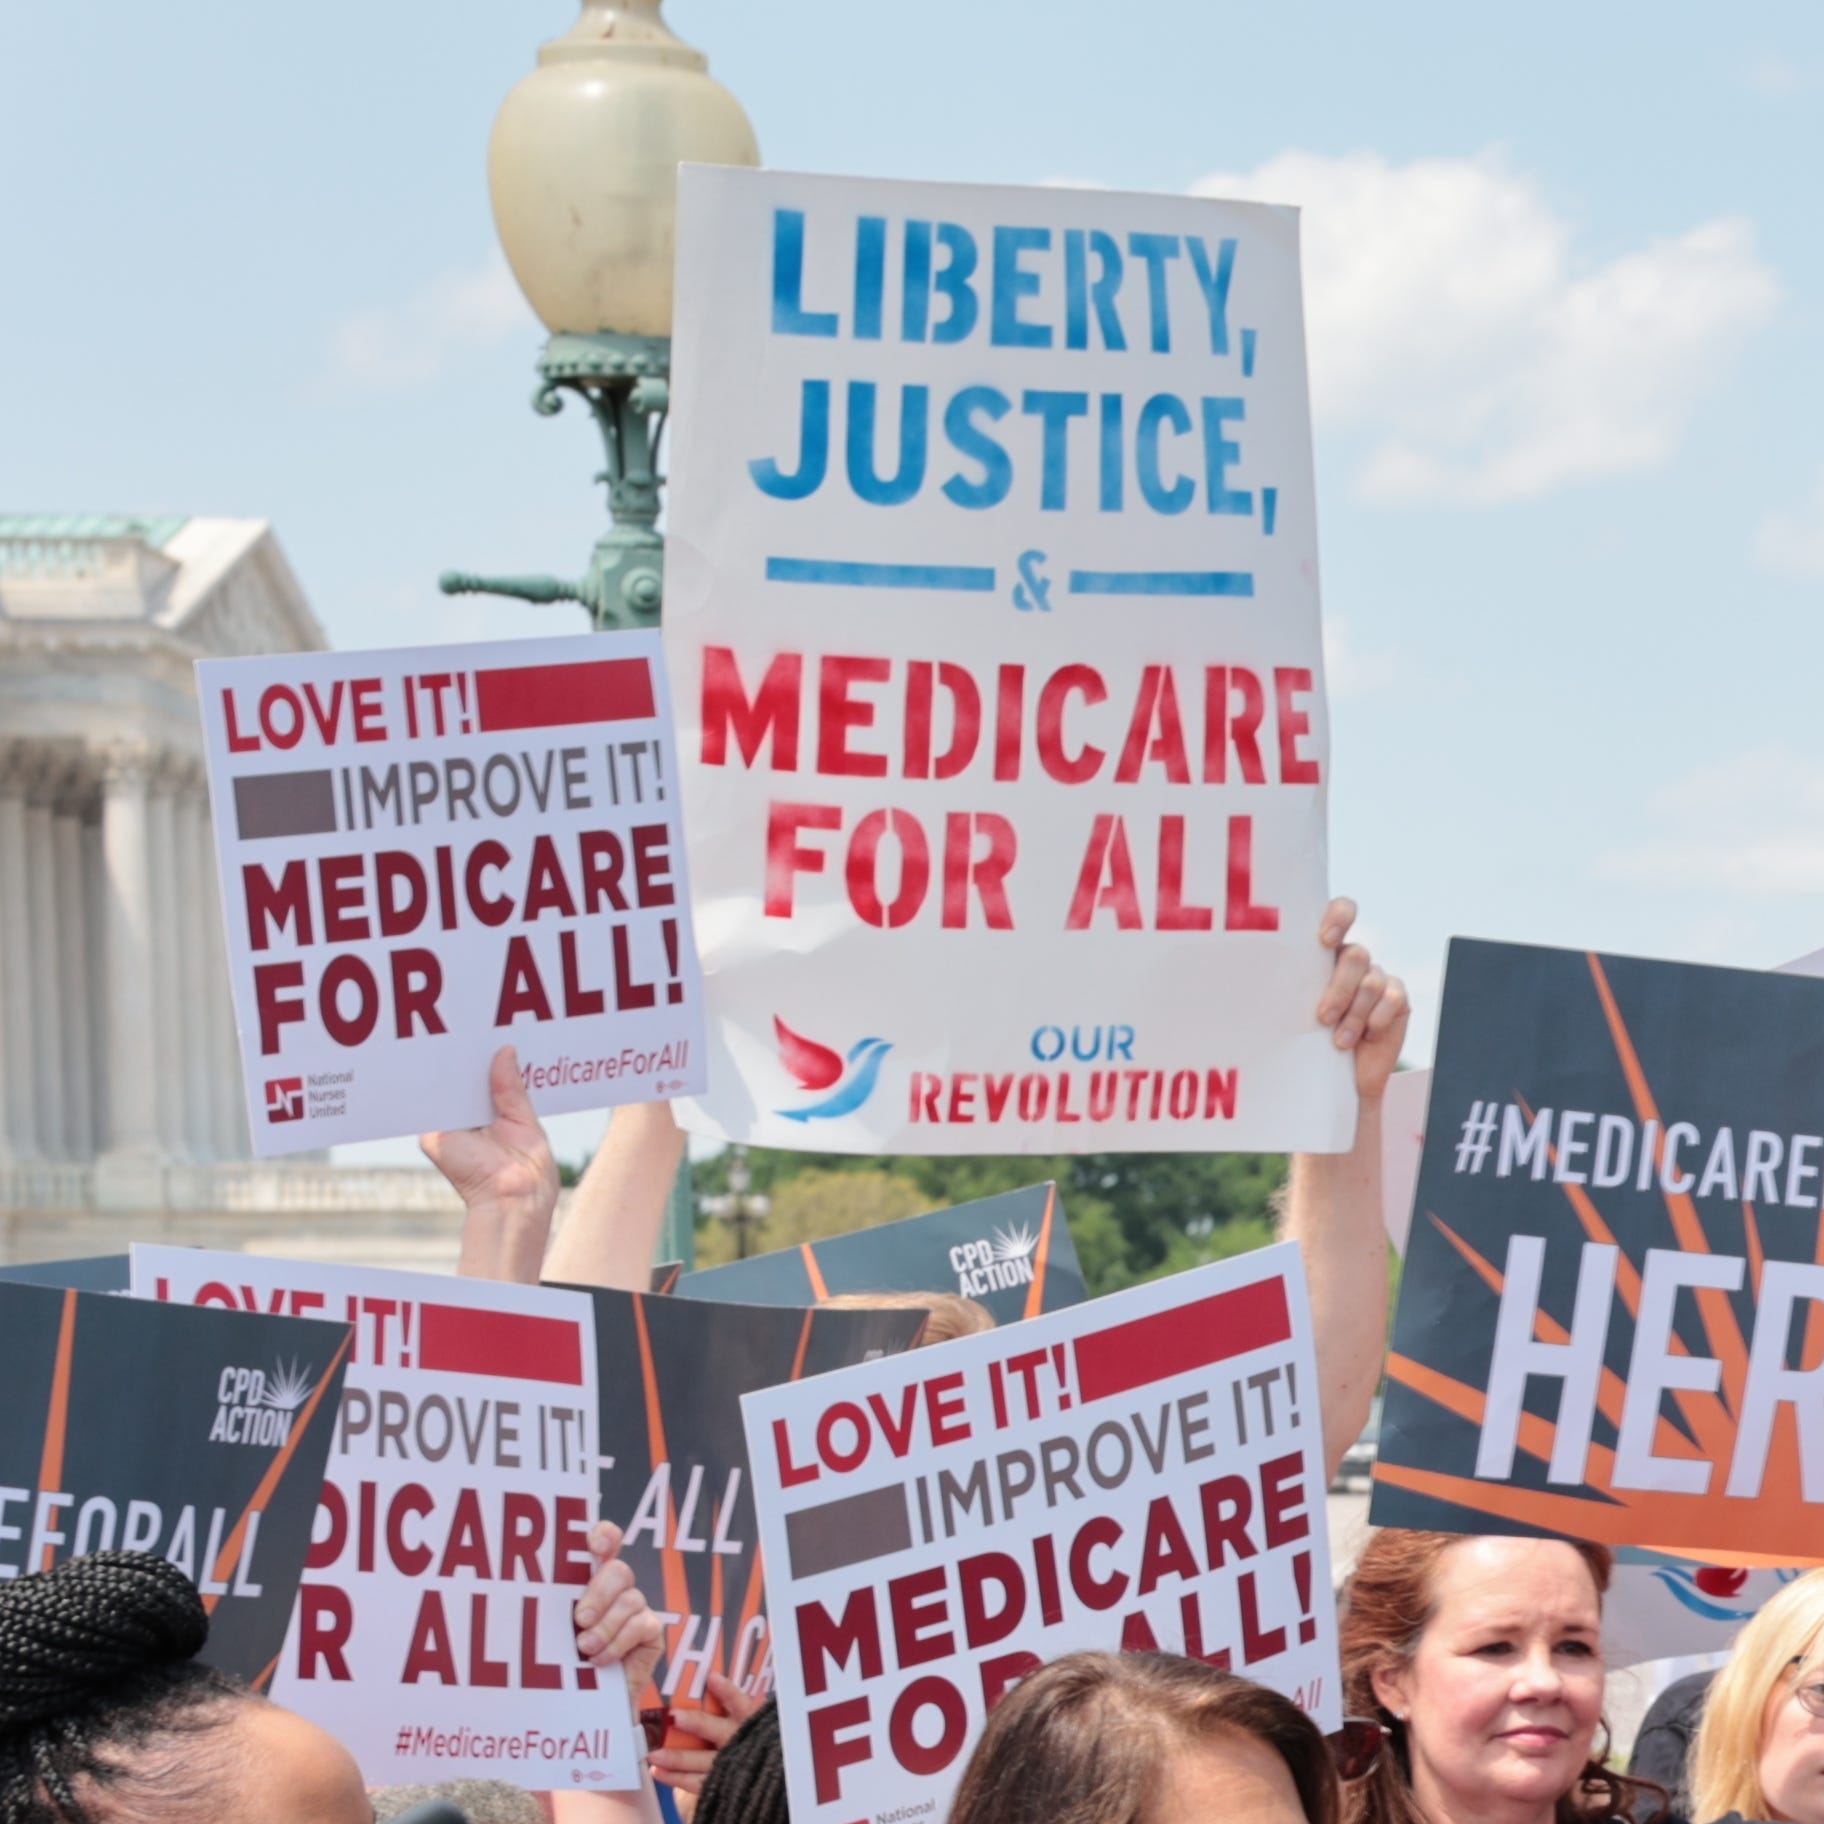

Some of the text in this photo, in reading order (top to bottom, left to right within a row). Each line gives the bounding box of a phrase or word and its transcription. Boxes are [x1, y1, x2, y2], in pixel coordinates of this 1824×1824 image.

[770, 208, 1257, 376] LIBERTY,
[747, 378, 1279, 535] JUSTICE,
[1011, 548, 1052, 611] &
[220, 672, 476, 753] LOVE IT!
[698, 645, 1321, 786] MEDICARE
[339, 740, 667, 830] IMPROVE IT!
[241, 824, 676, 951] MEDICARE
[763, 800, 1280, 933] FOR ALL
[254, 919, 684, 1055] FOR ALL!
[307, 1070, 354, 1086] National
[520, 1040, 689, 1089] MedicareForAll
[1030, 1022, 1135, 1063] OUR
[309, 1089, 347, 1103] Nurses
[309, 1104, 346, 1118] United
[909, 1067, 1239, 1124] REVOLUTION
[949, 1240, 994, 1272] CPD
[960, 1256, 1035, 1299] ACTION
[209, 1405, 293, 1447] ACTION
[218, 1366, 266, 1406] CPD
[772, 1342, 1073, 1488] LOVE IT!
[339, 1387, 587, 1474] PROVE IT!
[914, 1363, 1301, 1544] IMPROVE IT!
[303, 1479, 592, 1585] DICARE
[622, 1462, 743, 1554] ALL
[795, 1450, 1311, 1696] MEDICARE
[395, 1726, 609, 1760] #MedicareForAll
